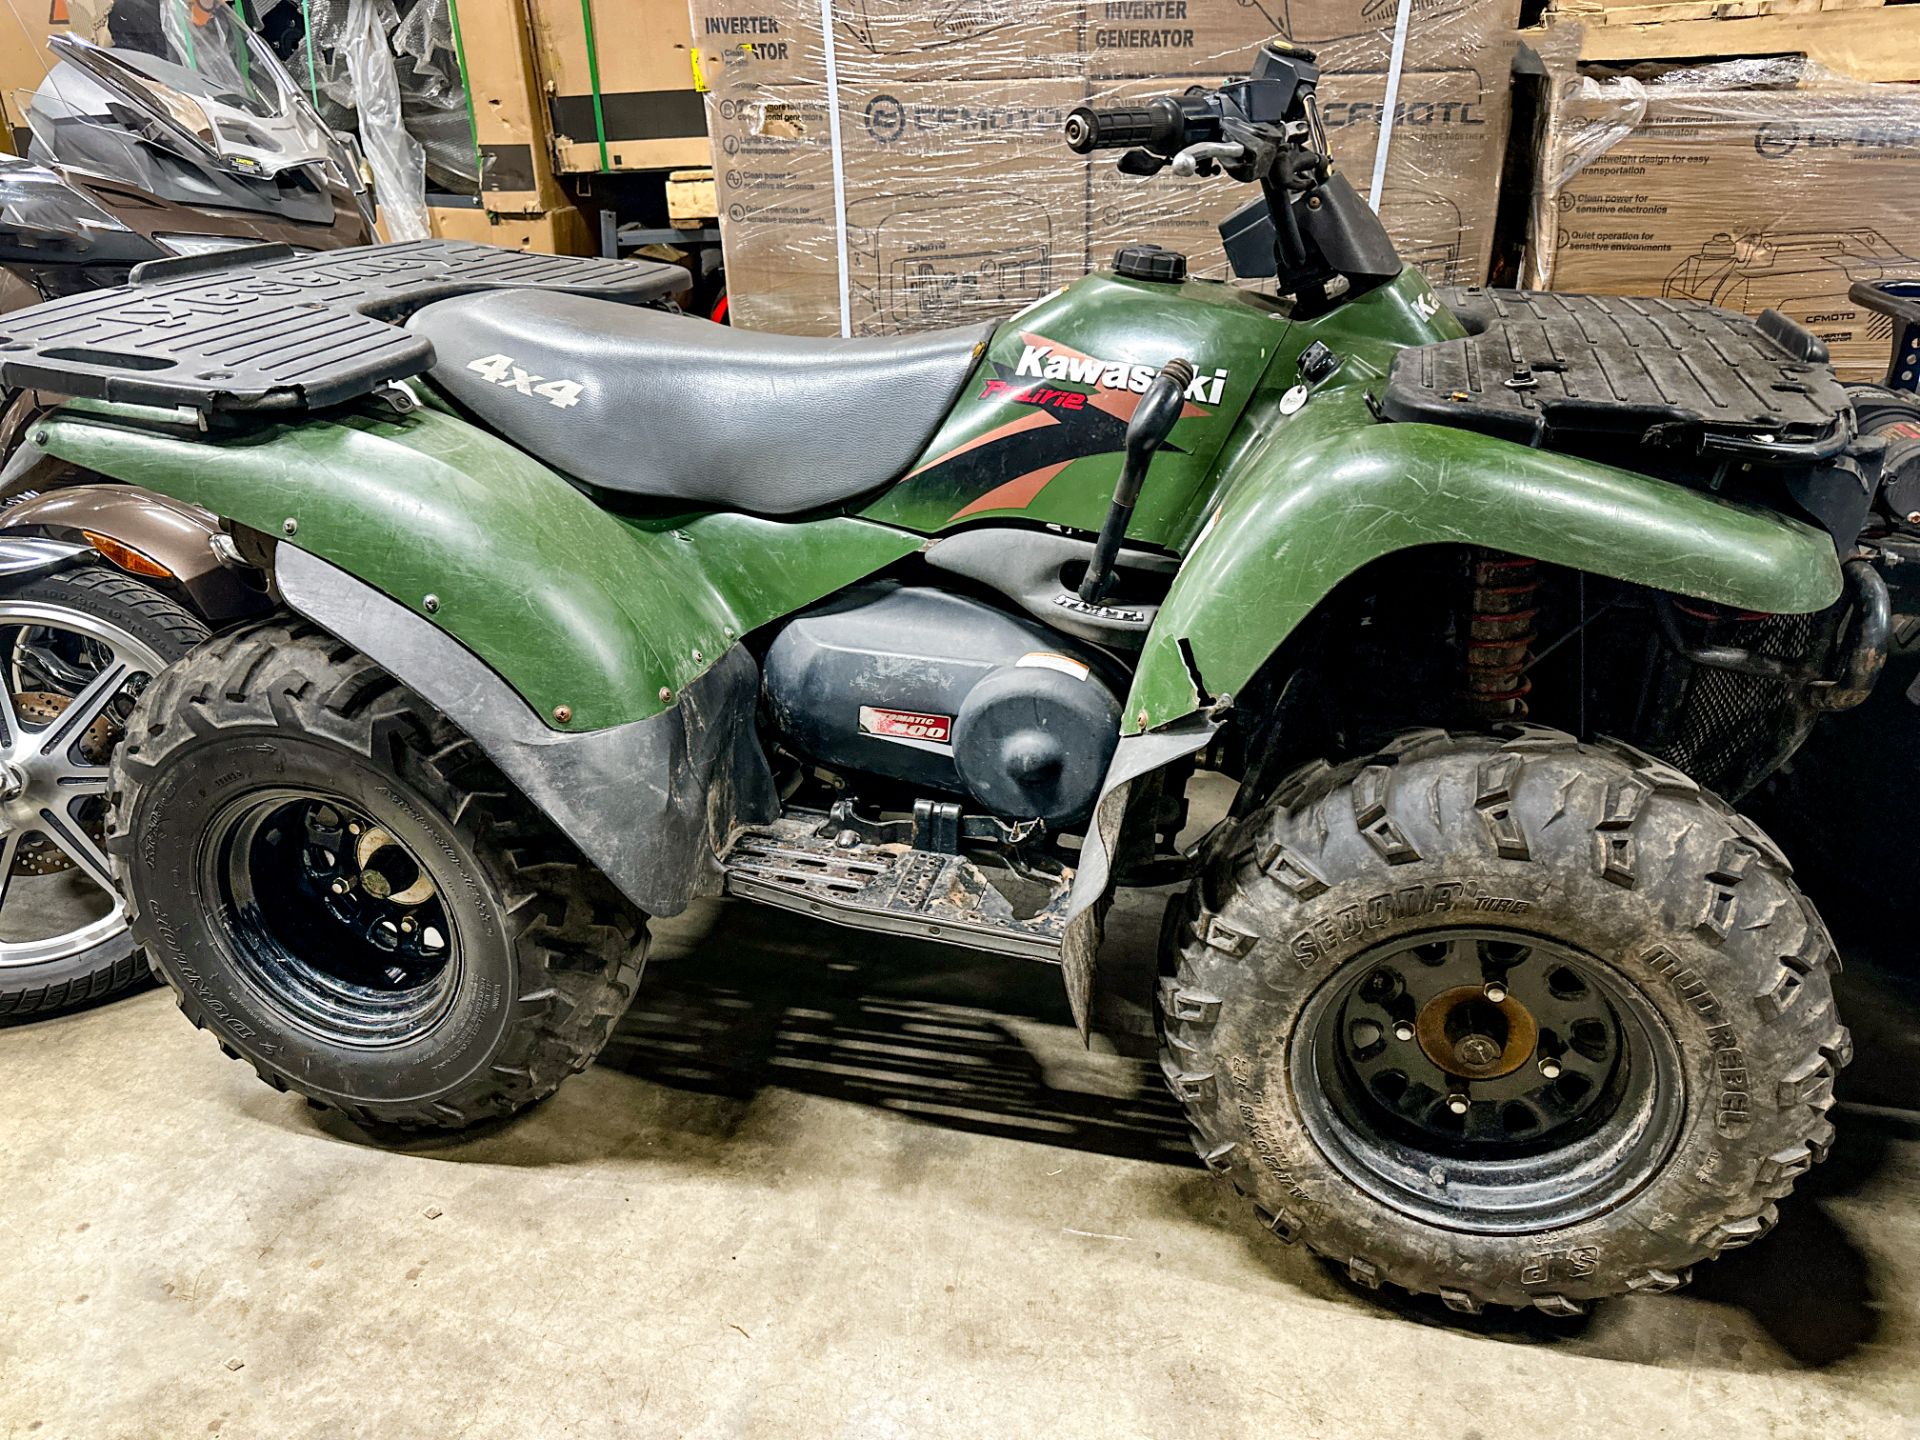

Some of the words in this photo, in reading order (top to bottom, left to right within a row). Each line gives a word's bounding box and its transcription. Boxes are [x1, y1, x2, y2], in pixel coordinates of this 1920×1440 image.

[1105, 1, 1187, 19] INVERTER
[705, 16, 779, 34] INVERTER
[1095, 29, 1194, 48] GENERATOR
[1638, 155, 1670, 165] design
[1671, 156, 1686, 164] for
[1686, 156, 1711, 165] easy
[1581, 166, 1646, 177] transportation
[1577, 194, 1603, 203] Clean
[1604, 195, 1634, 204] power
[1635, 194, 1649, 203] for
[1576, 205, 1616, 214] sensitive
[1617, 205, 1668, 214] electronics
[1571, 231, 1596, 240] Quiet
[1596, 231, 1638, 241] operation
[1641, 232, 1655, 240] for
[1569, 243, 1609, 252] sensitive
[1610, 242, 1672, 252] environments
[1805, 312, 1857, 323] CFMOTO
[1014, 344, 1229, 406] Kawaski
[1289, 880, 1456, 970] SEDONA
[1473, 896, 1530, 914] TIRE
[1639, 943, 1722, 1015] MUD
[1704, 1022, 1751, 1130] REBEL
